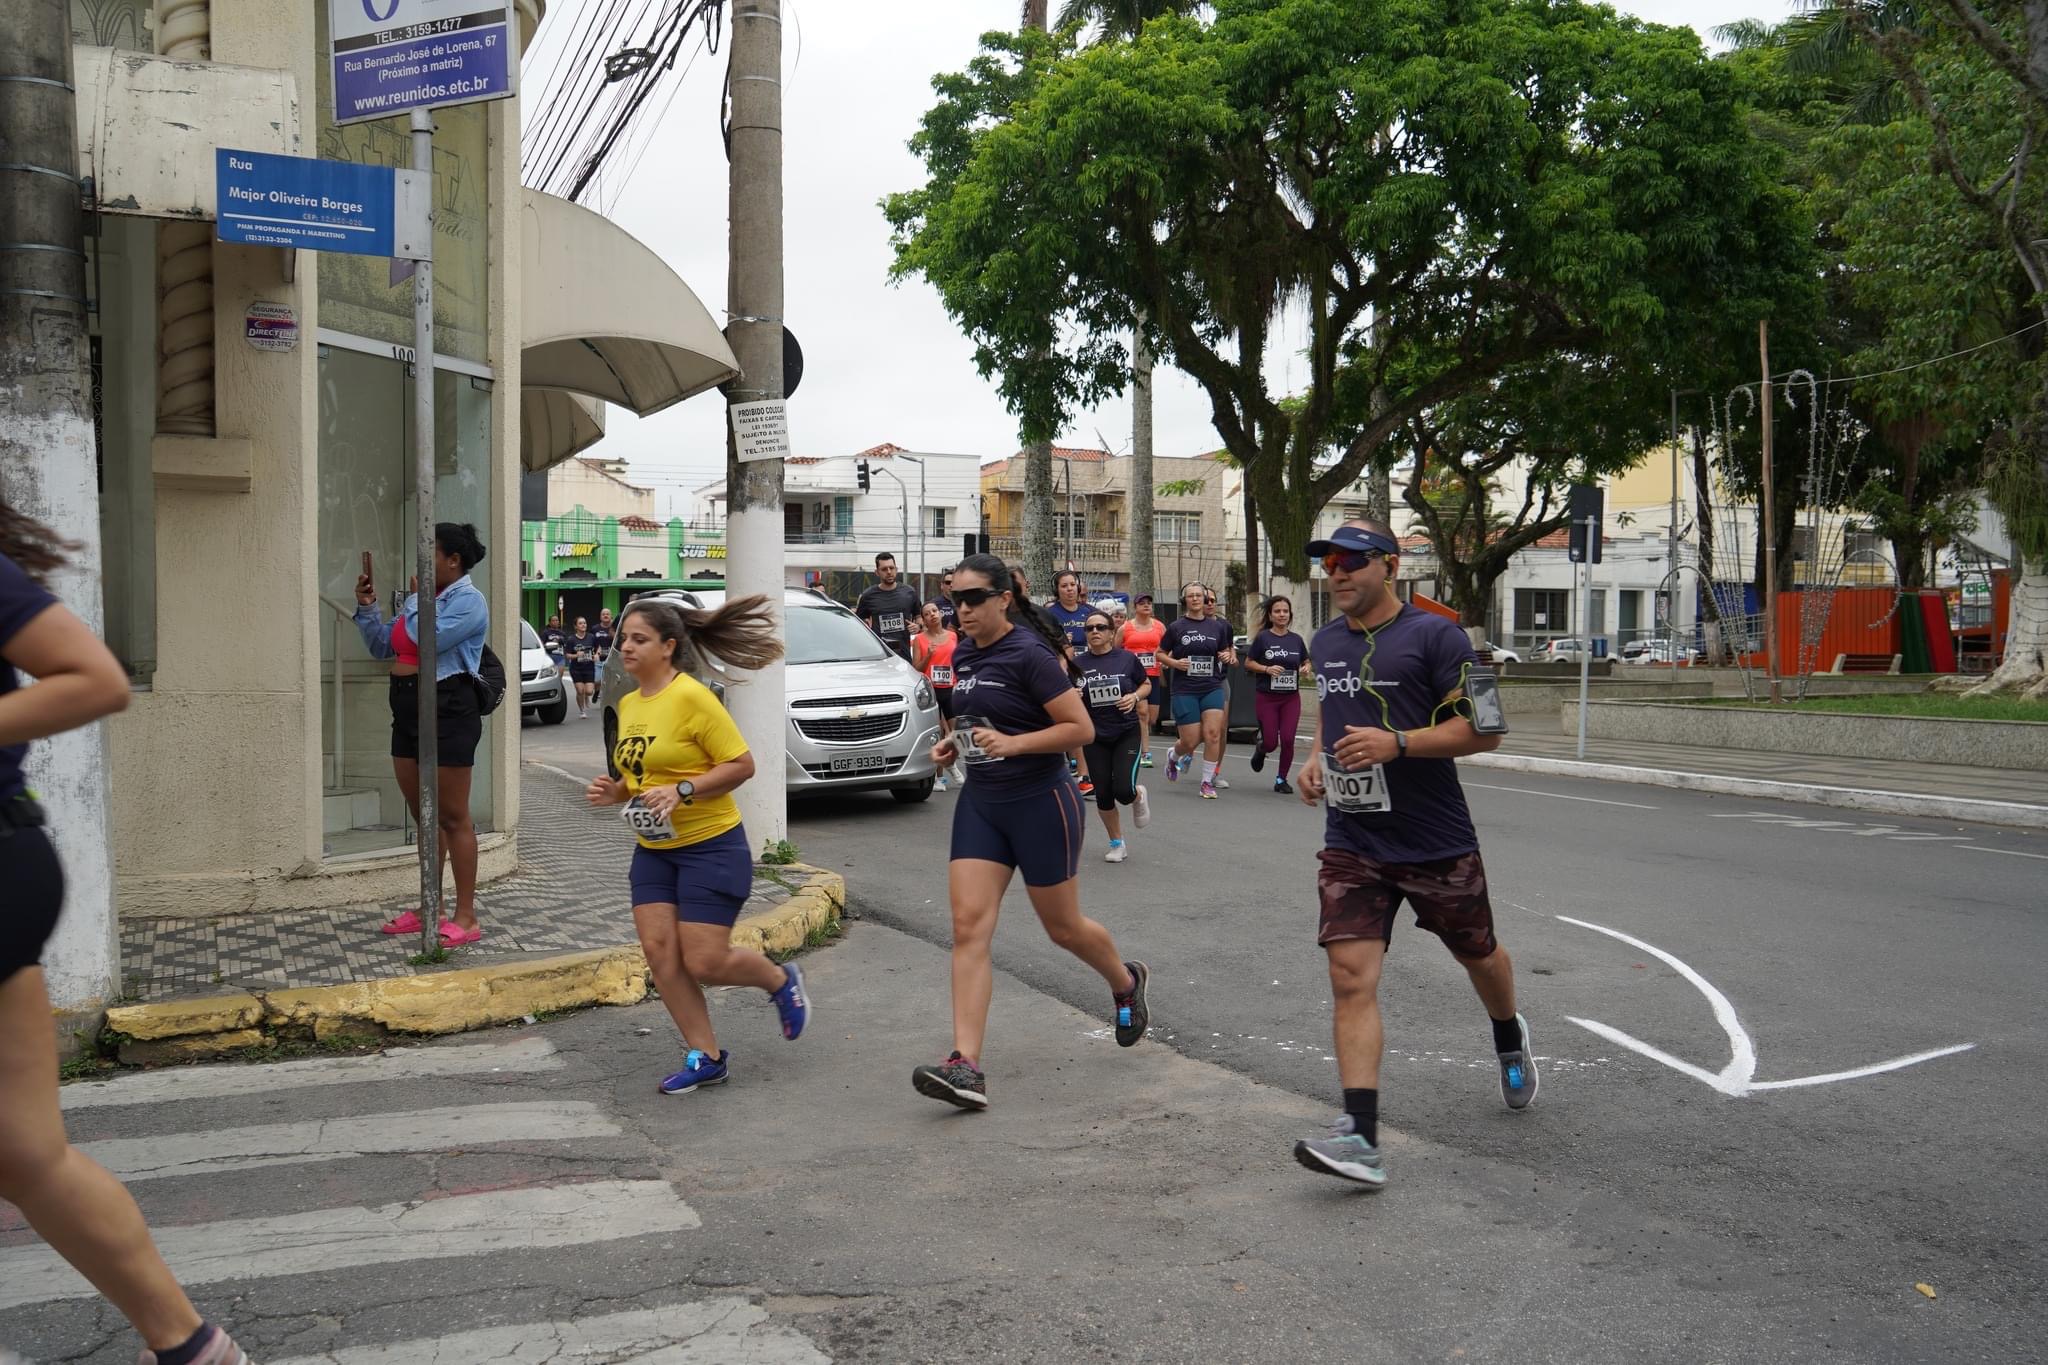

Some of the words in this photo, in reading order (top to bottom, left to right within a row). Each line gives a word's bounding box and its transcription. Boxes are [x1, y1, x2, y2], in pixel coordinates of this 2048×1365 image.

[374, 31, 402, 45] TEL.:
[406, 18, 462, 38] 3159-1477
[344, 62, 362, 72] Rua
[364, 54, 406, 69] Bernardo
[408, 48, 430, 60] José
[432, 45, 444, 56] de
[447, 39, 483, 54] Lorena,
[485, 35, 497, 47] 67
[378, 66, 420, 83] (Próximo
[422, 65, 429, 73] a
[430, 57, 463, 72] matriz)
[354, 76, 489, 111] www.reunidos.etc.br
[229, 157, 253, 171] Rua
[229, 187, 266, 203] Major
[269, 191, 318, 208] Oliveira
[321, 198, 363, 214] Borges
[255, 225, 301, 235] PROPAGANDA
[307, 230, 346, 239] MARKETING
[742, 431, 767, 439] SUJEITO
[552, 541, 599, 558] SUBWAY
[679, 544, 727, 559] SUBWA
[883, 619, 901, 628] 1108
[1191, 633, 1206, 645] edp
[1274, 648, 1288, 658] edp
[1191, 662, 1211, 670] 1044
[933, 671, 951, 679] 1100
[1275, 676, 1294, 685] 1405
[1327, 670, 1362, 698] edp
[1090, 687, 1120, 700] 1110
[1330, 775, 1373, 796] 1007
